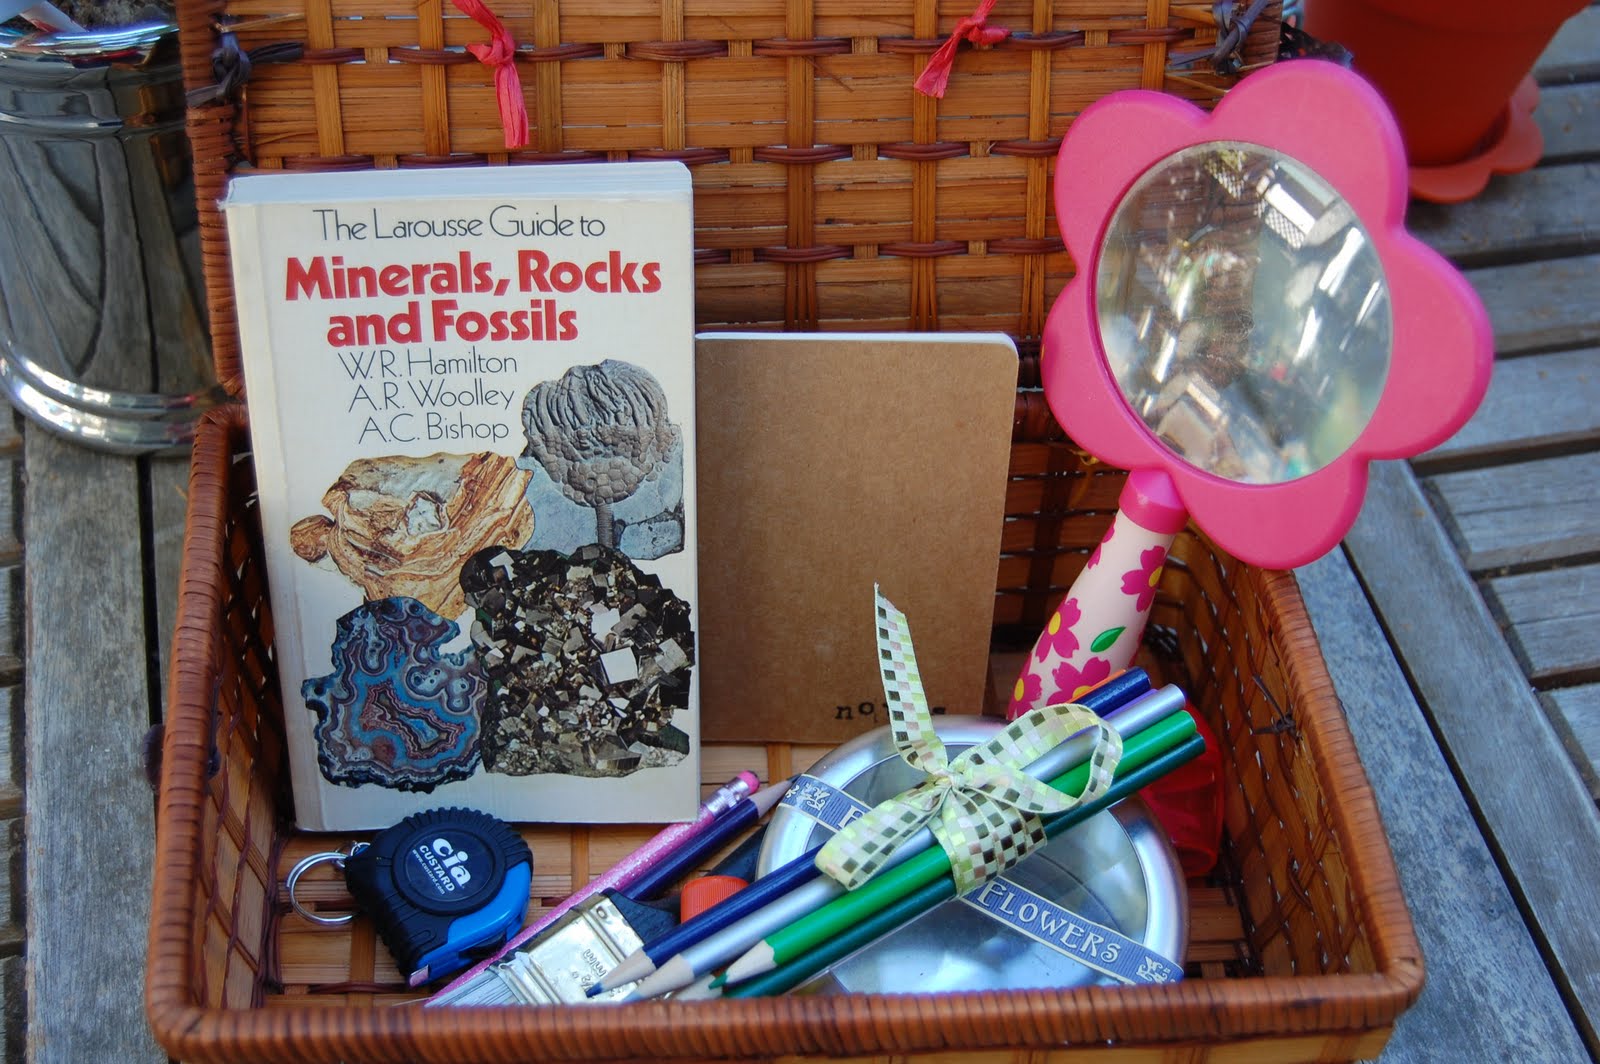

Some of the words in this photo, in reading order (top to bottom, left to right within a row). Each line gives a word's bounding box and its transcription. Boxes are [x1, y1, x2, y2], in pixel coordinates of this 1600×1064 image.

[313, 209, 367, 241] The
[374, 208, 483, 239] Larousse
[490, 205, 574, 237] Guide
[580, 216, 605, 237] to
[286, 251, 510, 301] Minerals,
[518, 250, 661, 293] Rocks
[327, 302, 422, 347] and
[432, 300, 578, 341] Fossils
[338, 350, 403, 381] W.R.
[407, 347, 517, 376] Hamilton
[349, 384, 406, 412] A.R.
[408, 379, 514, 410] Woolley
[359, 415, 420, 444] A.C.
[427, 412, 509, 443] Bishop
[412, 849, 445, 895] www.custard.com
[419, 845, 455, 892] CUSTARD
[977, 880, 1121, 963] FLOWERS
